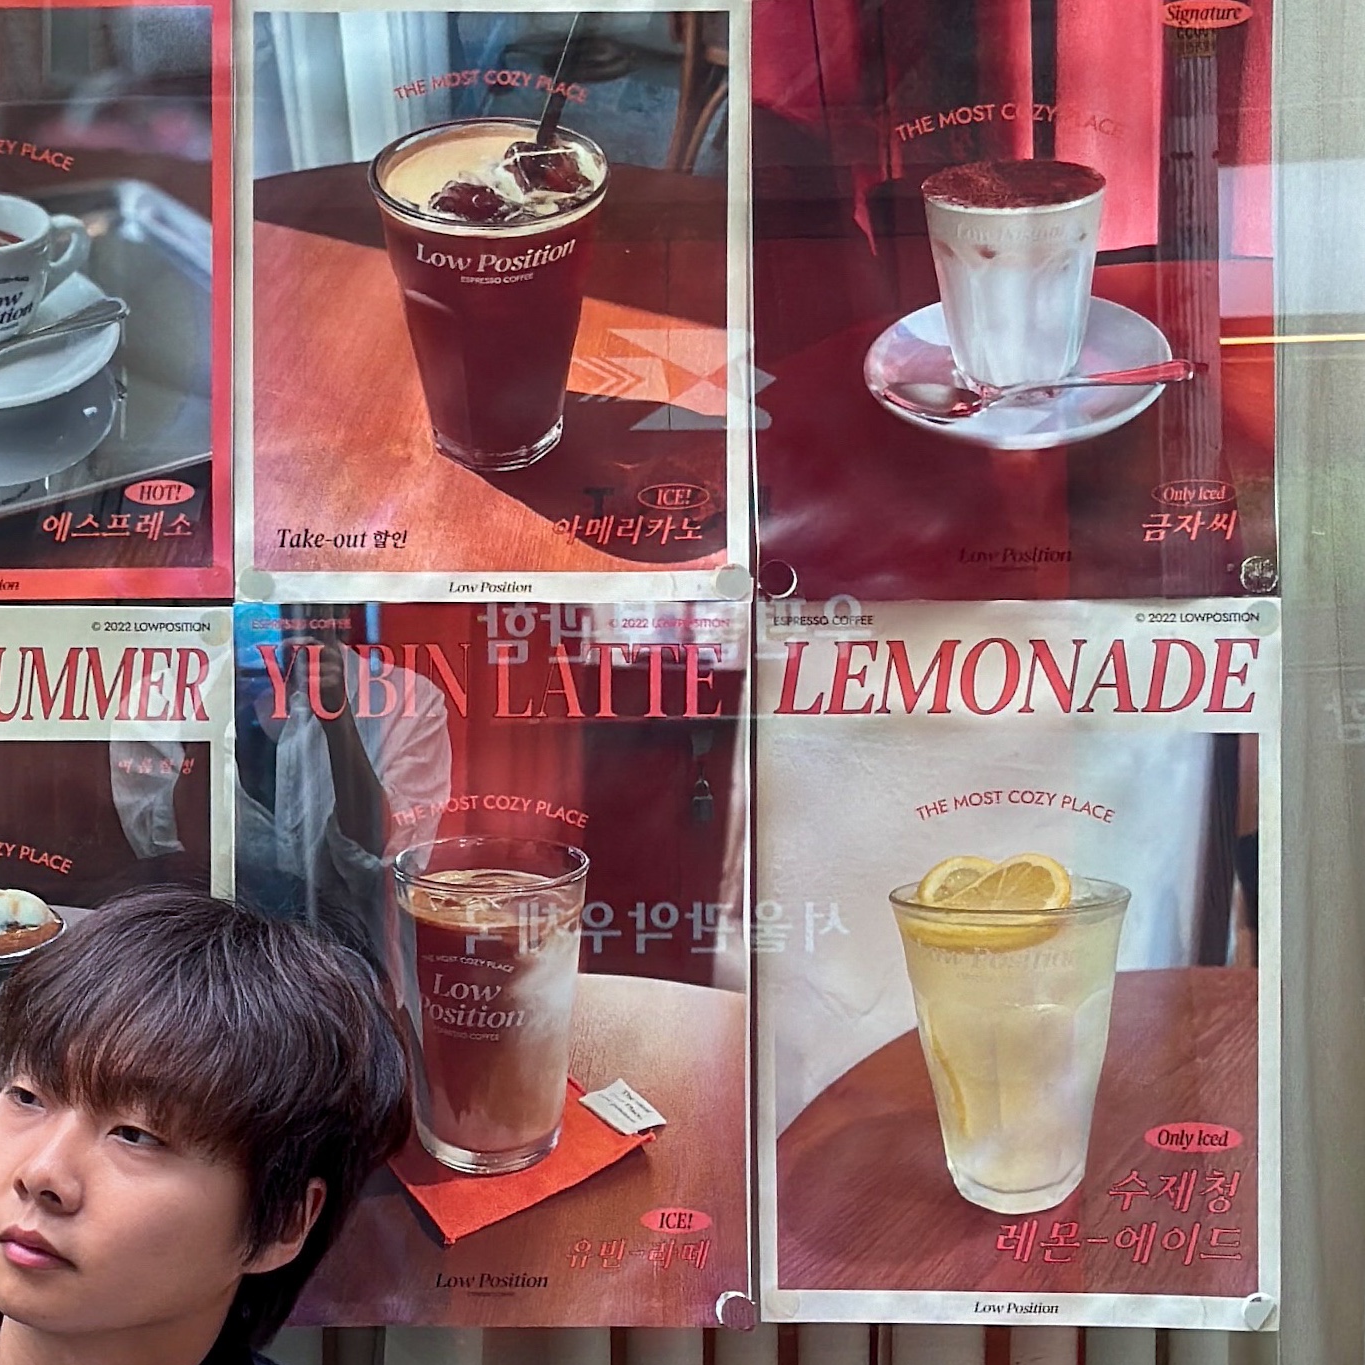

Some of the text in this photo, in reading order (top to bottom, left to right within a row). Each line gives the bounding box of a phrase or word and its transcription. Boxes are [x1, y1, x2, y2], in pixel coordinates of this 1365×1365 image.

[1166, 5, 1242, 25] Signature
[393, 68, 590, 105] THE MOST COZY PLACE
[895, 116, 937, 142] THE
[938, 103, 996, 129] MOST
[1000, 103, 1058, 121] CZY
[20, 142, 75, 172] PLACE
[416, 238, 577, 273] Low Position
[139, 484, 182, 501] HOT!
[656, 489, 692, 506] ICE!
[1163, 486, 1226, 504] Only Iced
[42, 510, 193, 543] 에스프레소
[552, 514, 703, 545] 아메리카노
[1141, 510, 1238, 541] 금자씨
[276, 527, 408, 551] Take-out 할인
[959, 546, 1073, 564] Low Position
[448, 580, 533, 593] Low Position
[103, 622, 131, 633] 2022
[133, 622, 211, 633] LOWPOSITION
[622, 618, 648, 628] 2022
[773, 615, 874, 626] ESPRESSO COFFEE
[1147, 612, 1177, 623] 2022
[1179, 612, 1260, 623] LOWPOSITION
[256, 643, 724, 720] YUBIN LATTE
[773, 637, 1260, 716] LEMONADE
[391, 795, 590, 830] THE MOST COZY PLACE
[916, 789, 1115, 824] THE MOST COZY PLACE
[19, 845, 73, 875] PLACE
[433, 973, 502, 1002] Low
[1157, 1128, 1229, 1150] Only Iced
[1108, 1169, 1240, 1216] 수제청
[659, 1212, 694, 1230] ICE!
[995, 1218, 1244, 1266] 레몬-에이드
[435, 1271, 549, 1289] Low Position
[973, 1301, 1059, 1316] Low Position
